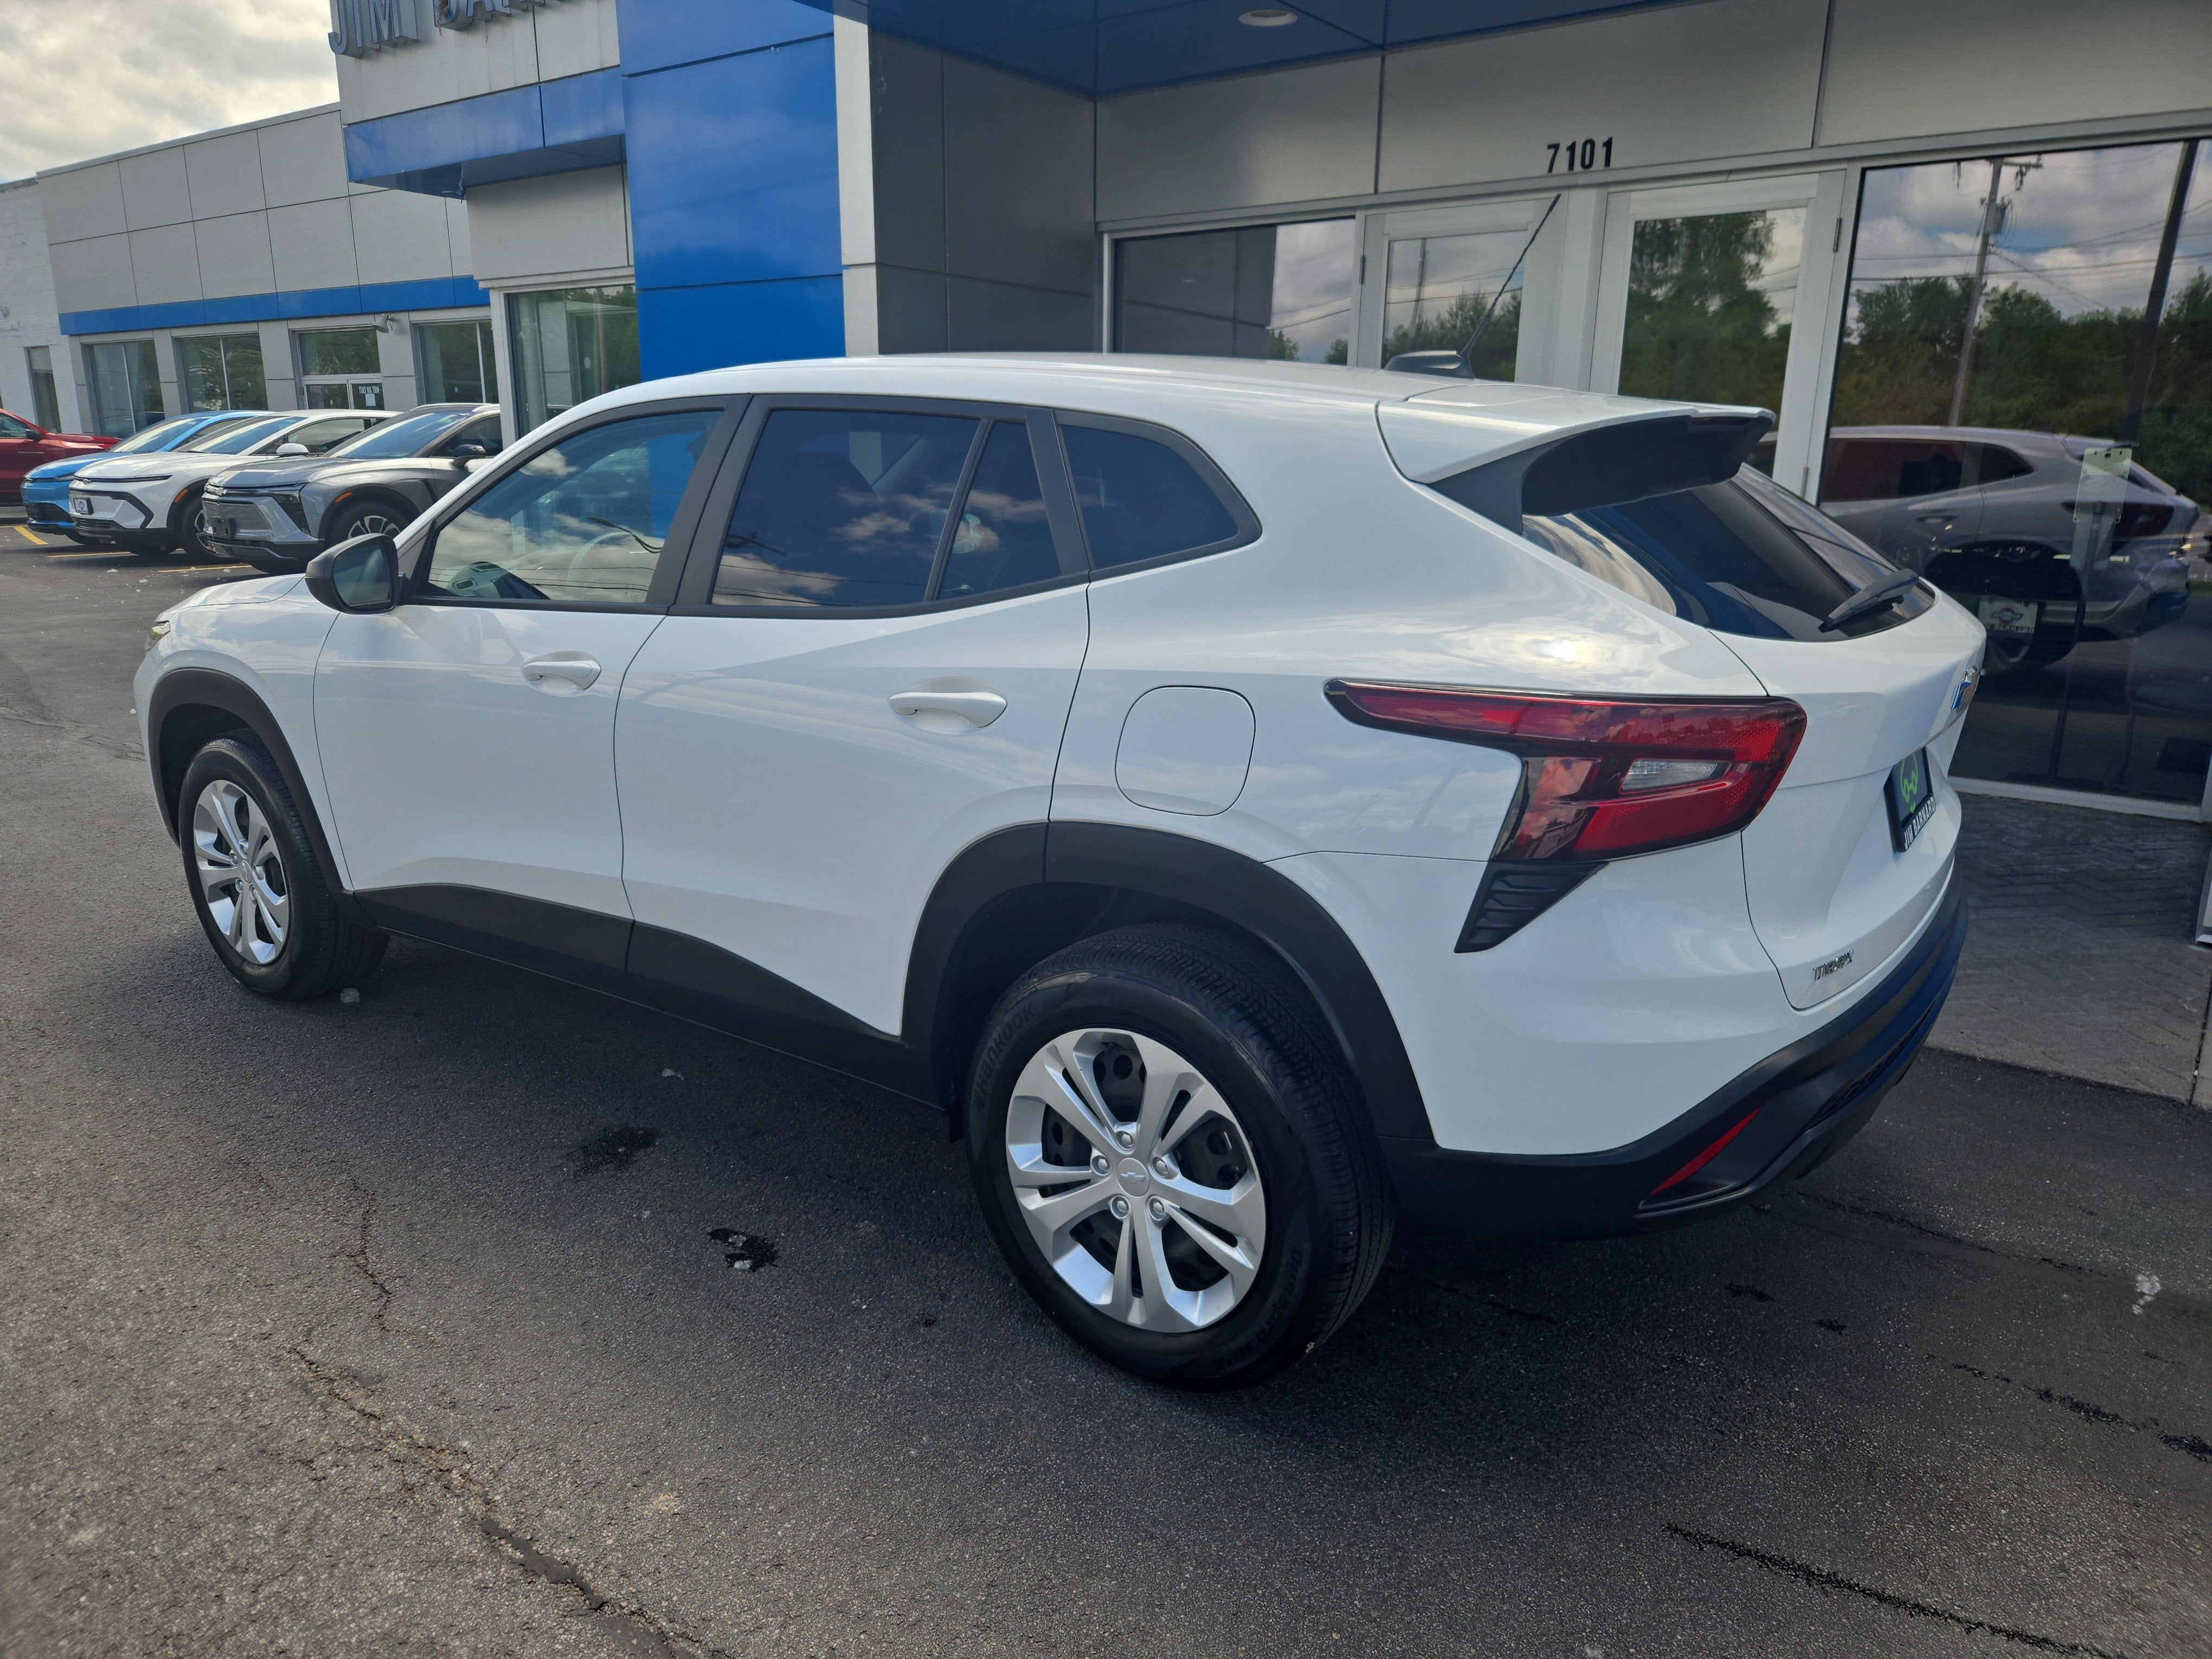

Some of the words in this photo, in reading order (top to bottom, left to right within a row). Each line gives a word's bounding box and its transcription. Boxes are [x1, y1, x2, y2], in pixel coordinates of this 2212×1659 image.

[328, 0, 400, 54] JIM
[1547, 137, 1613, 173] 7101
[1904, 824, 1914, 850] JIM
[1912, 796, 1935, 837] BARNARD
